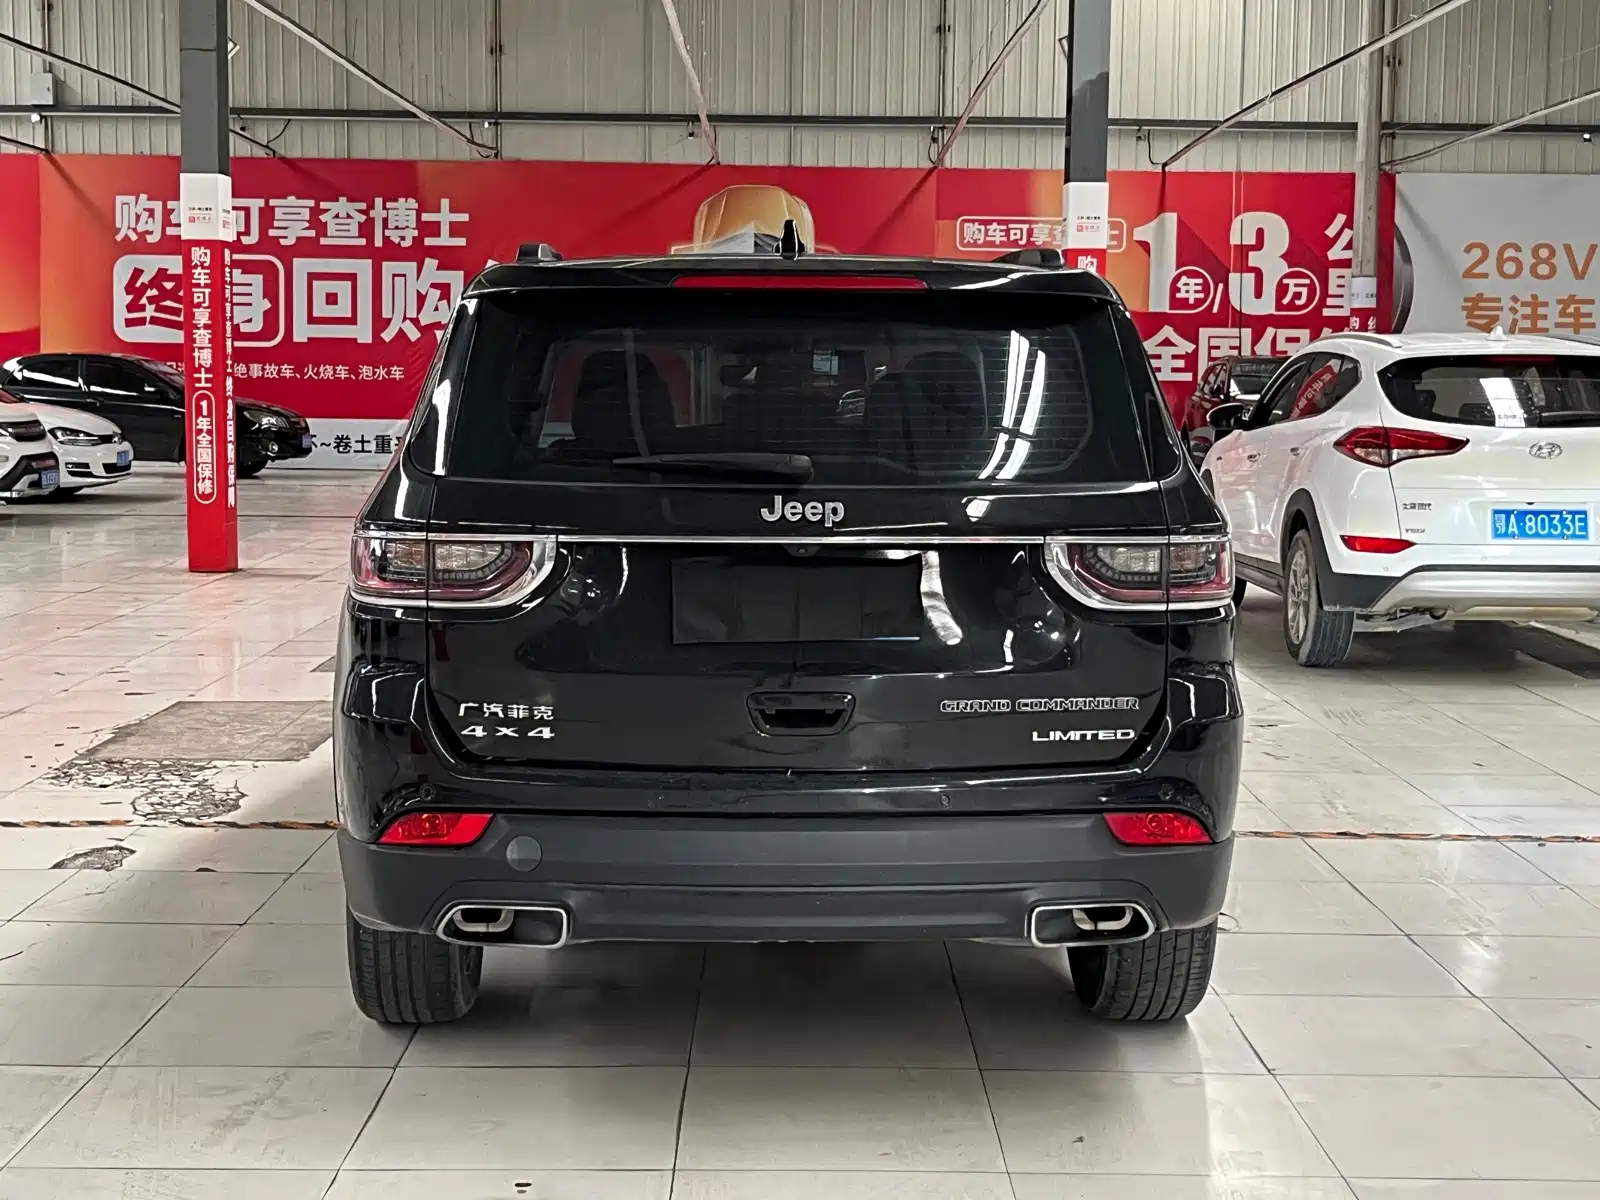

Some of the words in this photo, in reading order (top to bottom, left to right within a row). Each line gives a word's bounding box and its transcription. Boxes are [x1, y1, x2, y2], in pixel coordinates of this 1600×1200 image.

[1462, 242, 1598, 280] 268V
[191, 246, 213, 387] 购车可享查博士
[1143, 325, 1332, 382] 全国保
[196, 400, 213, 494] 1年全国保修
[760, 495, 845, 527] Jeep
[458, 702, 554, 720] 广汽菲克
[940, 700, 1011, 712] GRAND
[1016, 697, 1139, 711] COMMANDER
[1032, 729, 1135, 741] LIMITED
